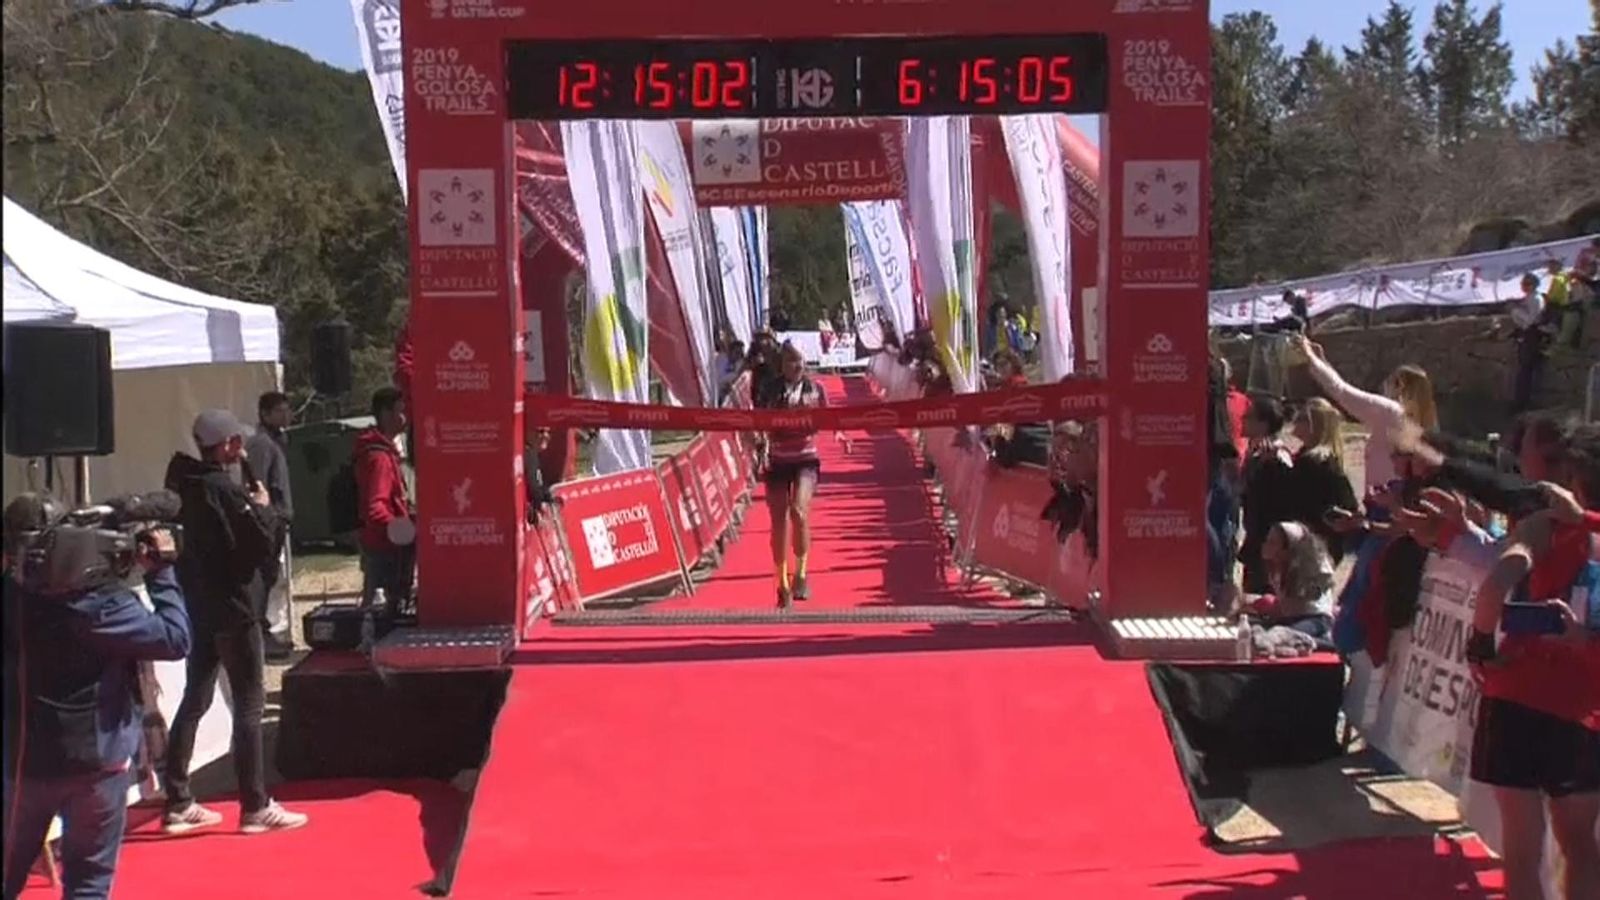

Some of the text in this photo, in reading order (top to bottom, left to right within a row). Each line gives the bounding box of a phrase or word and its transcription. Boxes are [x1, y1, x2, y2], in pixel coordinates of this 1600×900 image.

[412, 48, 459, 63] 2019
[1124, 40, 1170, 55] 2019
[1123, 56, 1197, 71] PENYA-
[412, 65, 486, 79] PENYA-
[1123, 71, 1206, 87] GOLOSA
[413, 80, 497, 95] GOLOSA
[899, 57, 1072, 106] 6:15:05
[1131, 86, 1197, 102] TRAILS
[424, 96, 488, 112] TRAILS
[762, 117, 875, 133] DIPUTAC
[764, 161, 885, 183] CASTELL
